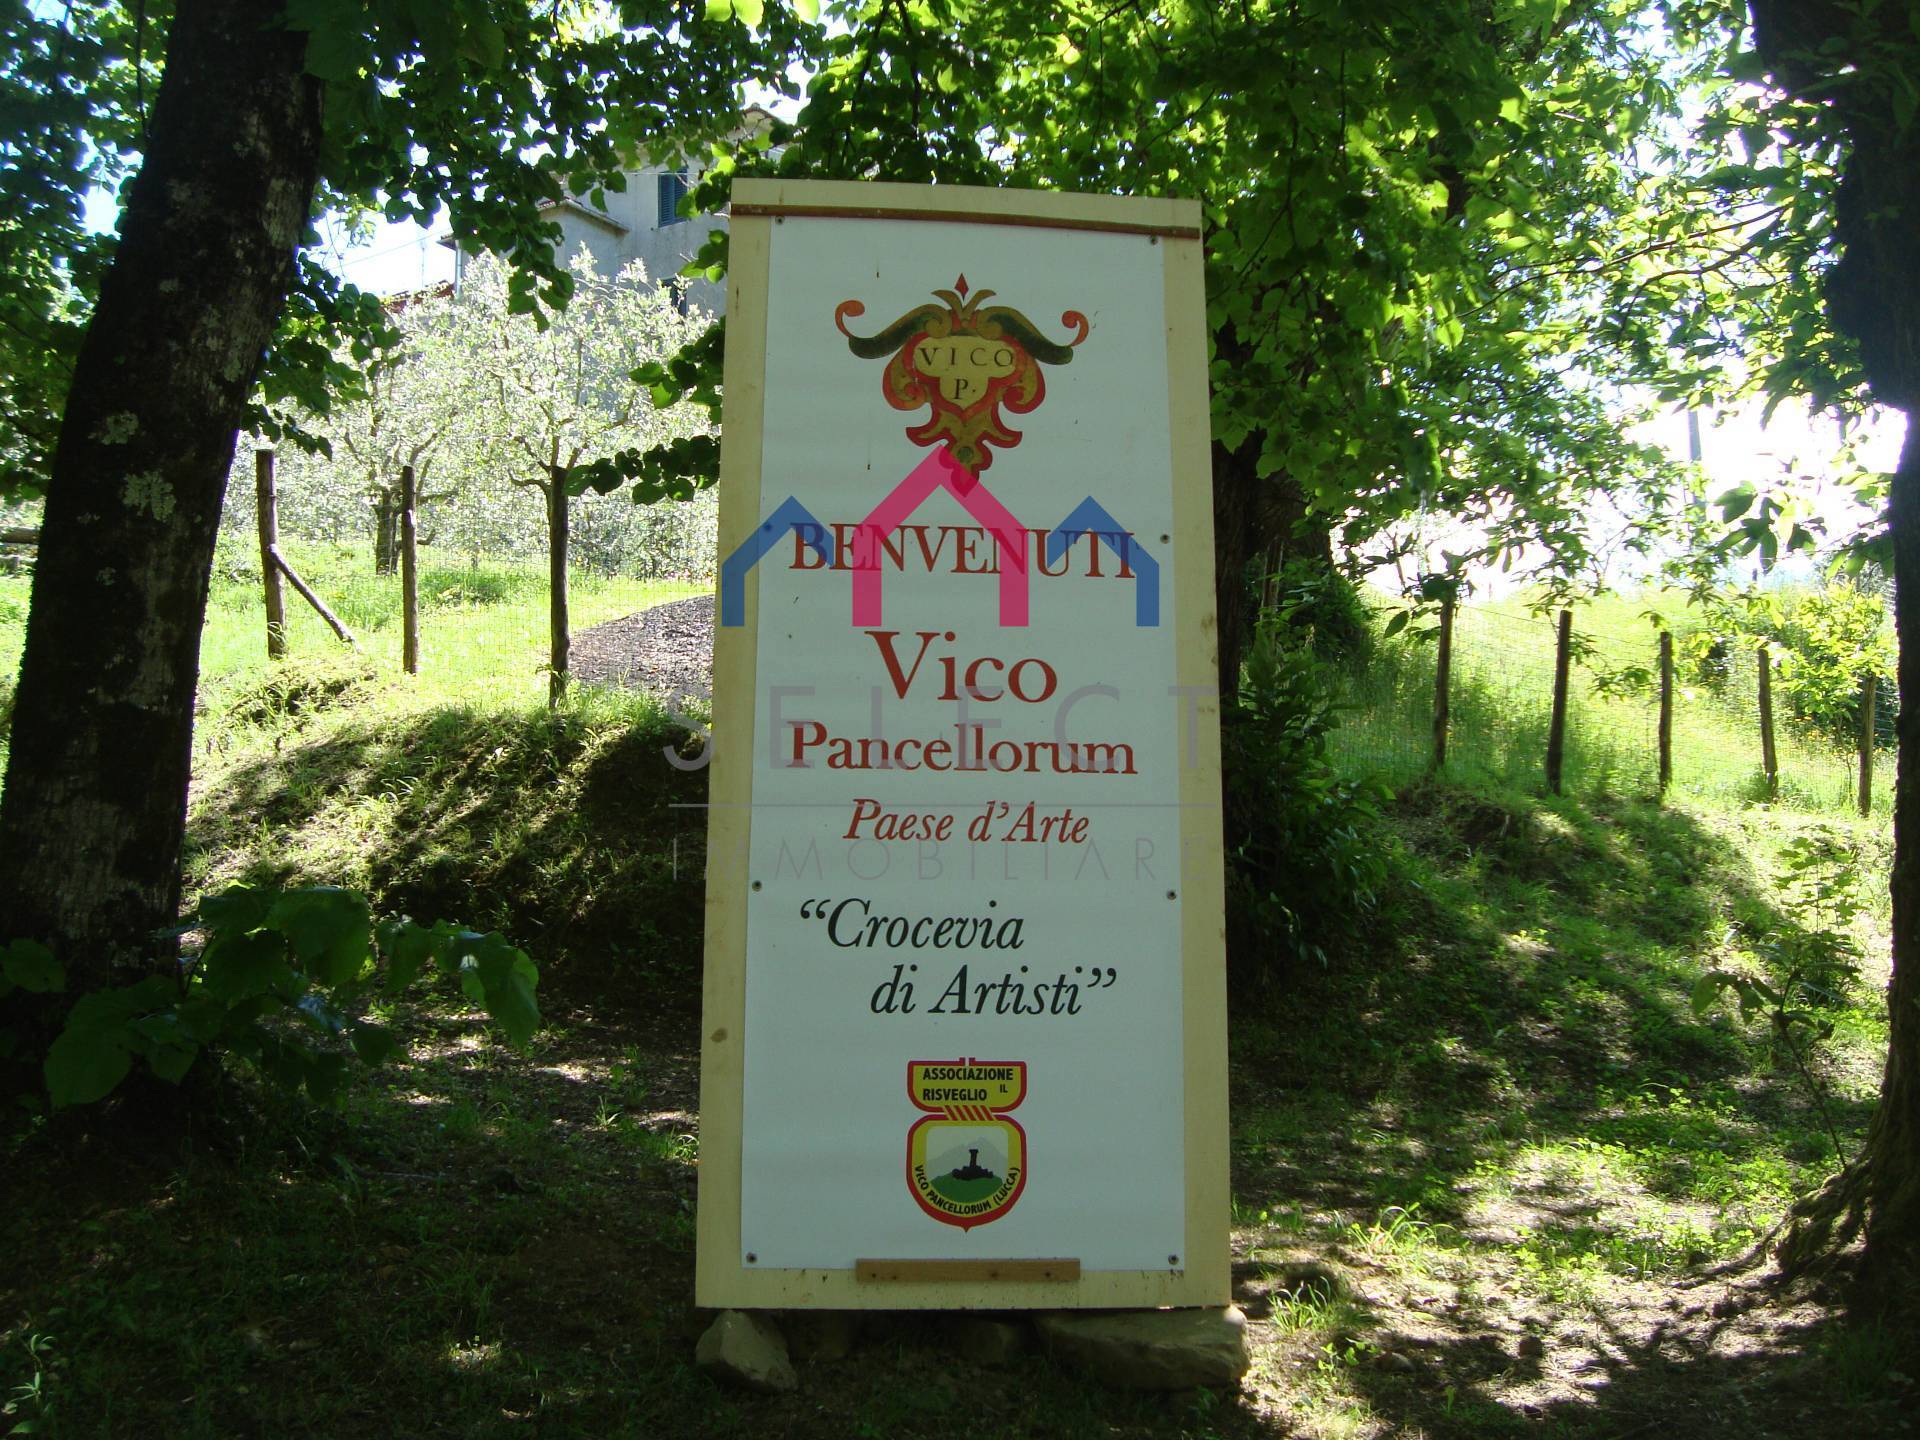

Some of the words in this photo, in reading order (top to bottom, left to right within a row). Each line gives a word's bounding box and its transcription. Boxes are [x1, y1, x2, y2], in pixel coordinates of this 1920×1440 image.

[918, 346, 1015, 369] VICO
[789, 523, 1139, 579] BENVENUTI
[864, 630, 1058, 703] Vico
[786, 720, 1138, 775] Pancellorum
[842, 798, 953, 841] Paese
[870, 964, 917, 1014] di
[922, 1067, 1014, 1081] ASSOCIAZIONE
[922, 1088, 988, 1102] RISVEGLIO
[999, 1084, 1009, 1094] IL
[914, 1164, 929, 1190] VICO
[926, 1189, 992, 1215] PANCELLORUM
[992, 1166, 1021, 1206] (LUCCA)
